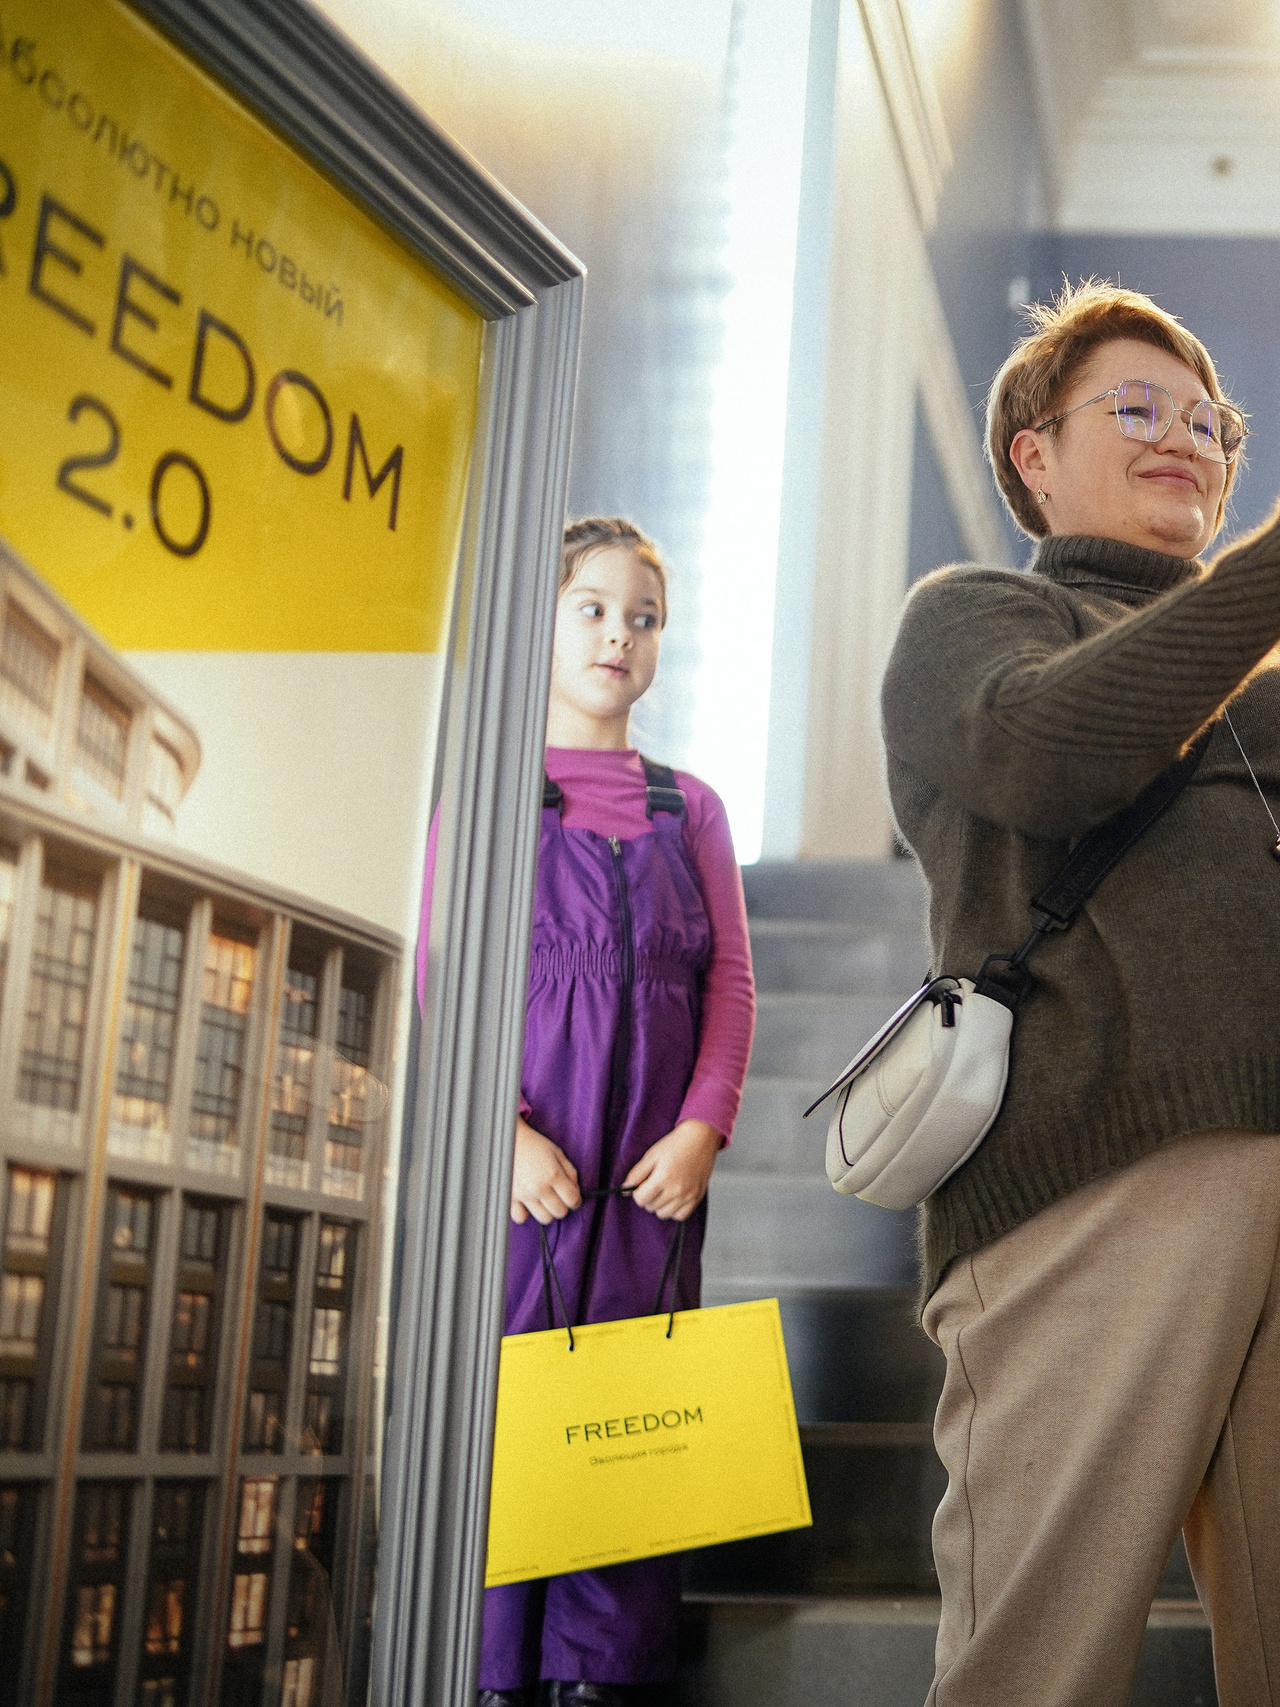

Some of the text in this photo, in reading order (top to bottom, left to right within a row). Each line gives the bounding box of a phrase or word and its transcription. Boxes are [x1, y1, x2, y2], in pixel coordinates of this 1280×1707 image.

[0, 35, 220, 232] бсолютно
[55, 391, 211, 560] 2.0
[566, 1406, 703, 1445] FREEDOM
